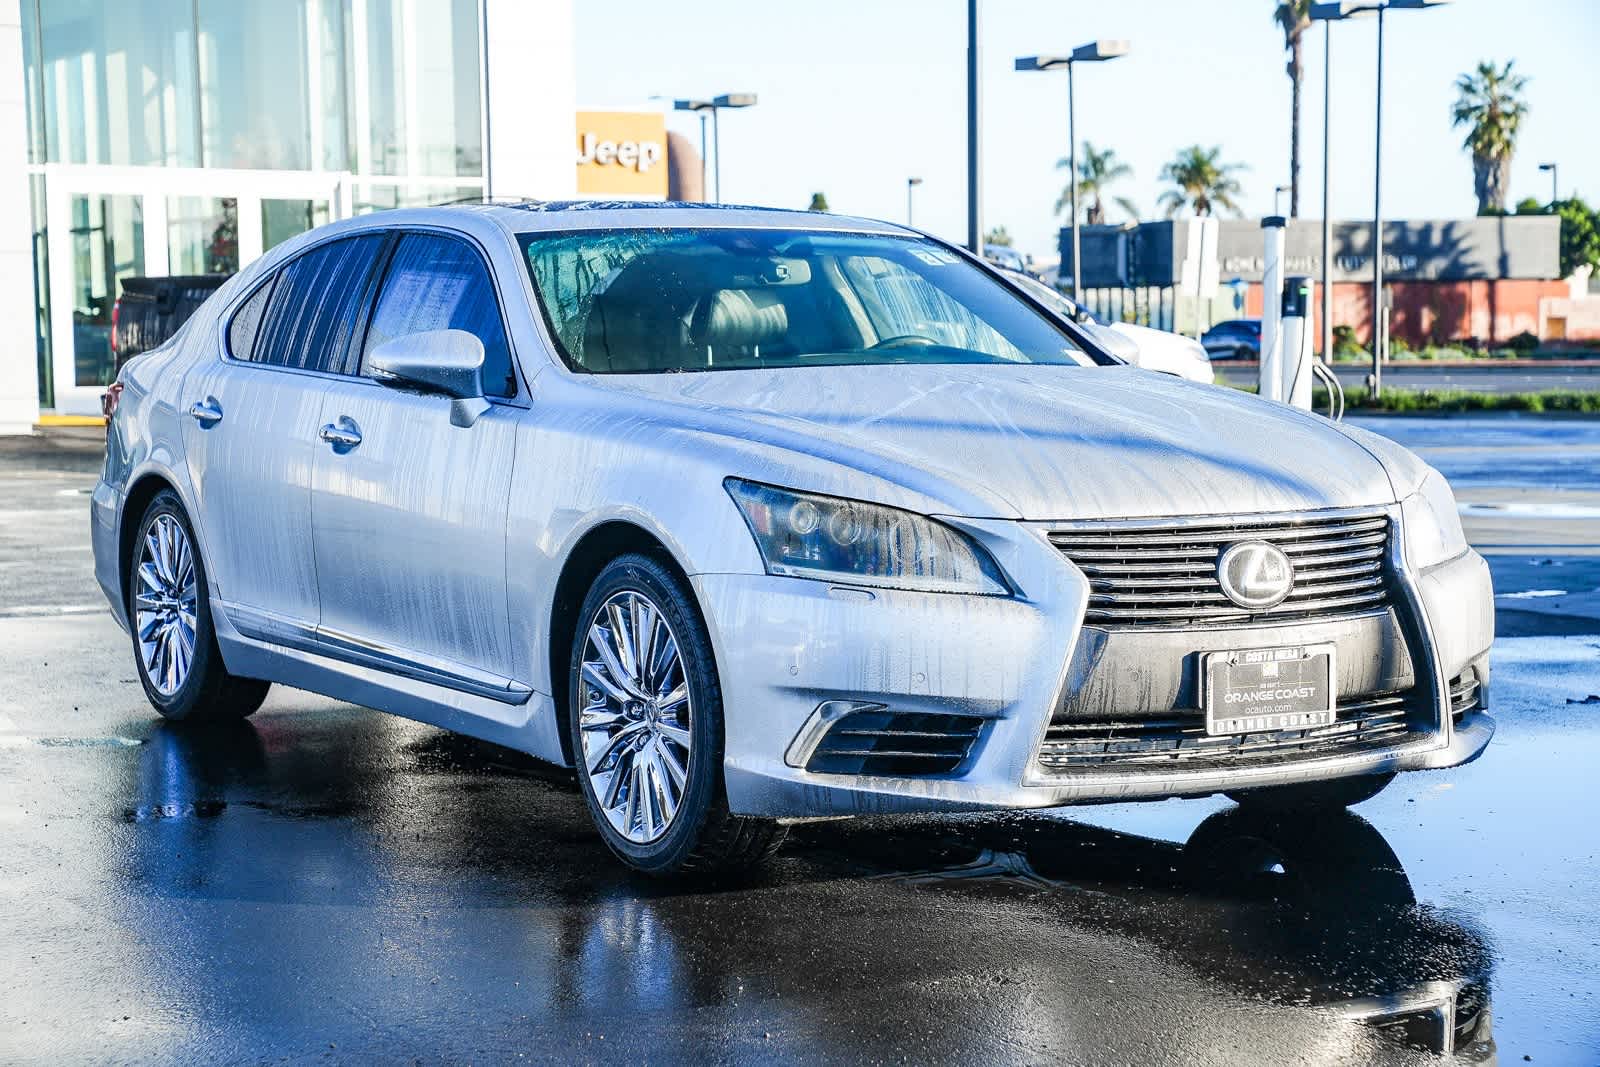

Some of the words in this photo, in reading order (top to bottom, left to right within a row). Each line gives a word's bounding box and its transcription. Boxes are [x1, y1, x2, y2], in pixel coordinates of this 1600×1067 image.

[576, 132, 661, 173] Jeep
[1224, 689, 1274, 704] ORANGE
[1275, 687, 1316, 700] COAST
[1245, 703, 1292, 714] ocauto.com
[1279, 712, 1328, 728] COAST
